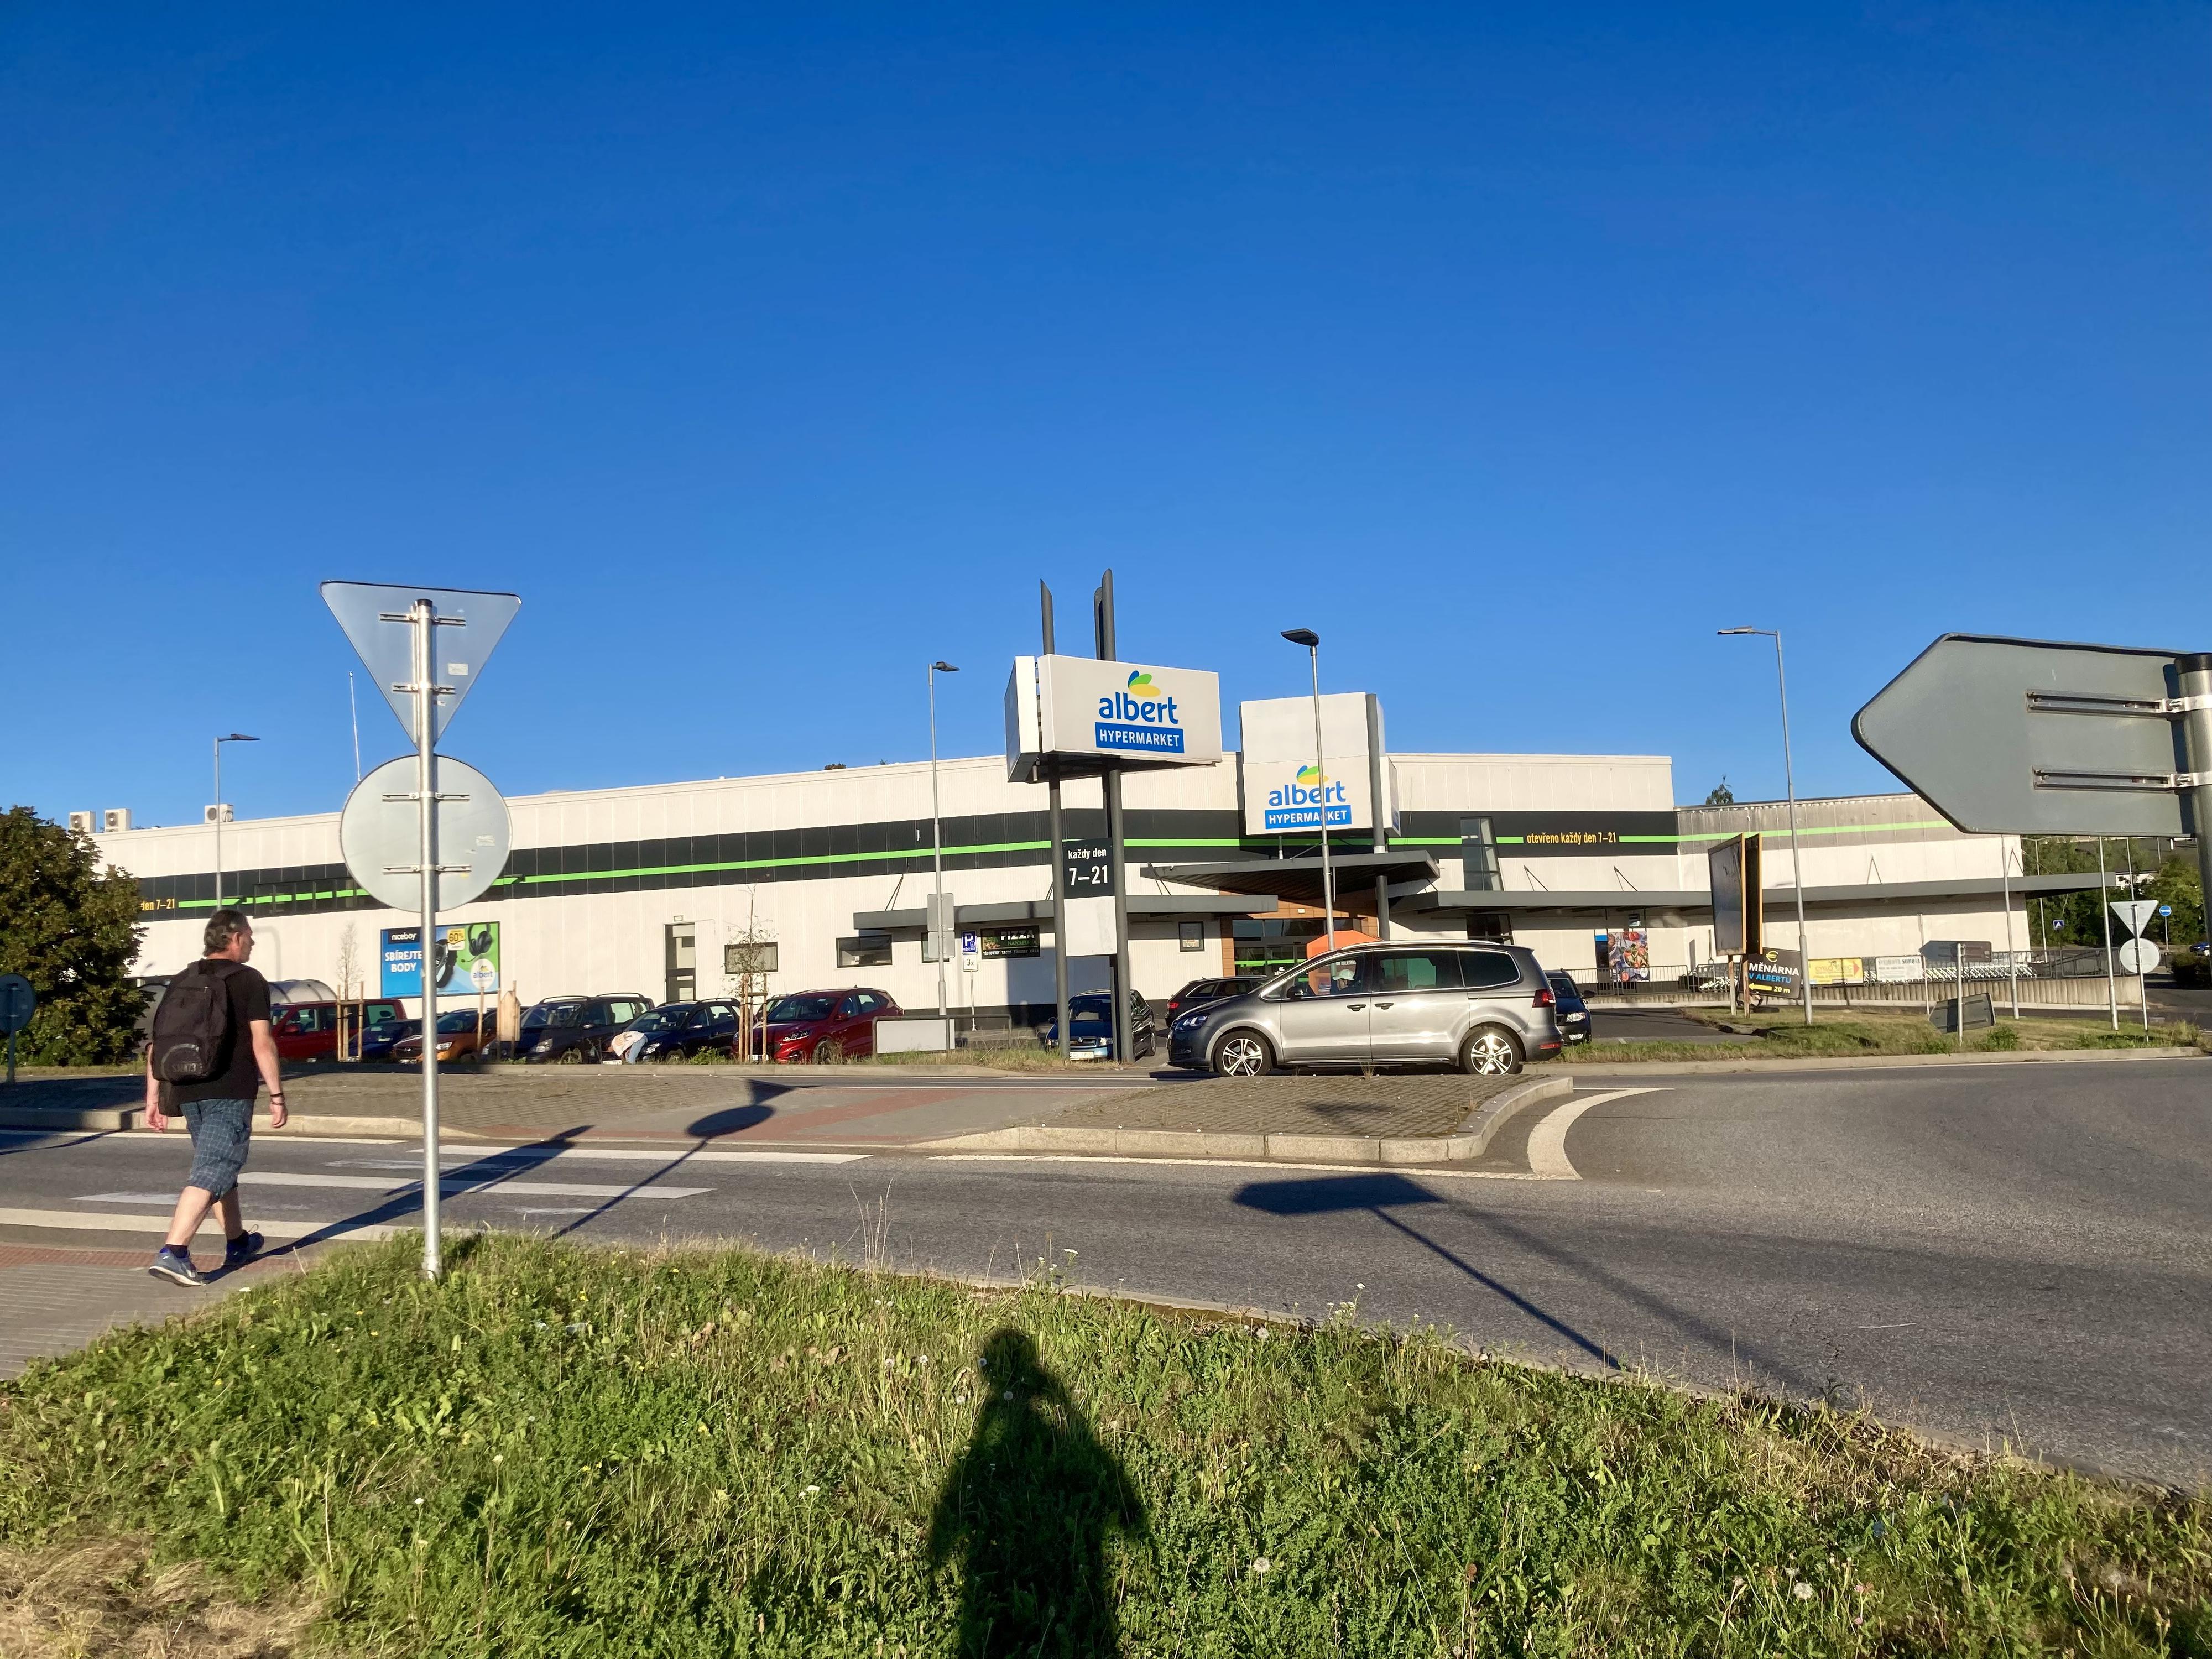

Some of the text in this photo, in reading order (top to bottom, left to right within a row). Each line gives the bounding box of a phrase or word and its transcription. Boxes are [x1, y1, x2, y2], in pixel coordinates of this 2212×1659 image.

[1099, 692, 1178, 724] albert
[1099, 729, 1179, 747] HYPERMARKET
[1269, 781, 1346, 806] albert
[1269, 810, 1347, 824] HYPERMAKET
[1527, 832, 1559, 844] otevřeno
[1561, 832, 1581, 845] každý
[1583, 832, 1597, 843] den
[1092, 848, 1107, 857] den
[964, 933, 973, 947] P
[1001, 930, 1035, 940] PIZZA
[385, 950, 422, 961] SBÍREJTE
[391, 962, 417, 973] BODY
[1749, 962, 1799, 976] MĚNÁRNA
[1756, 974, 1791, 984] ALBERTU
